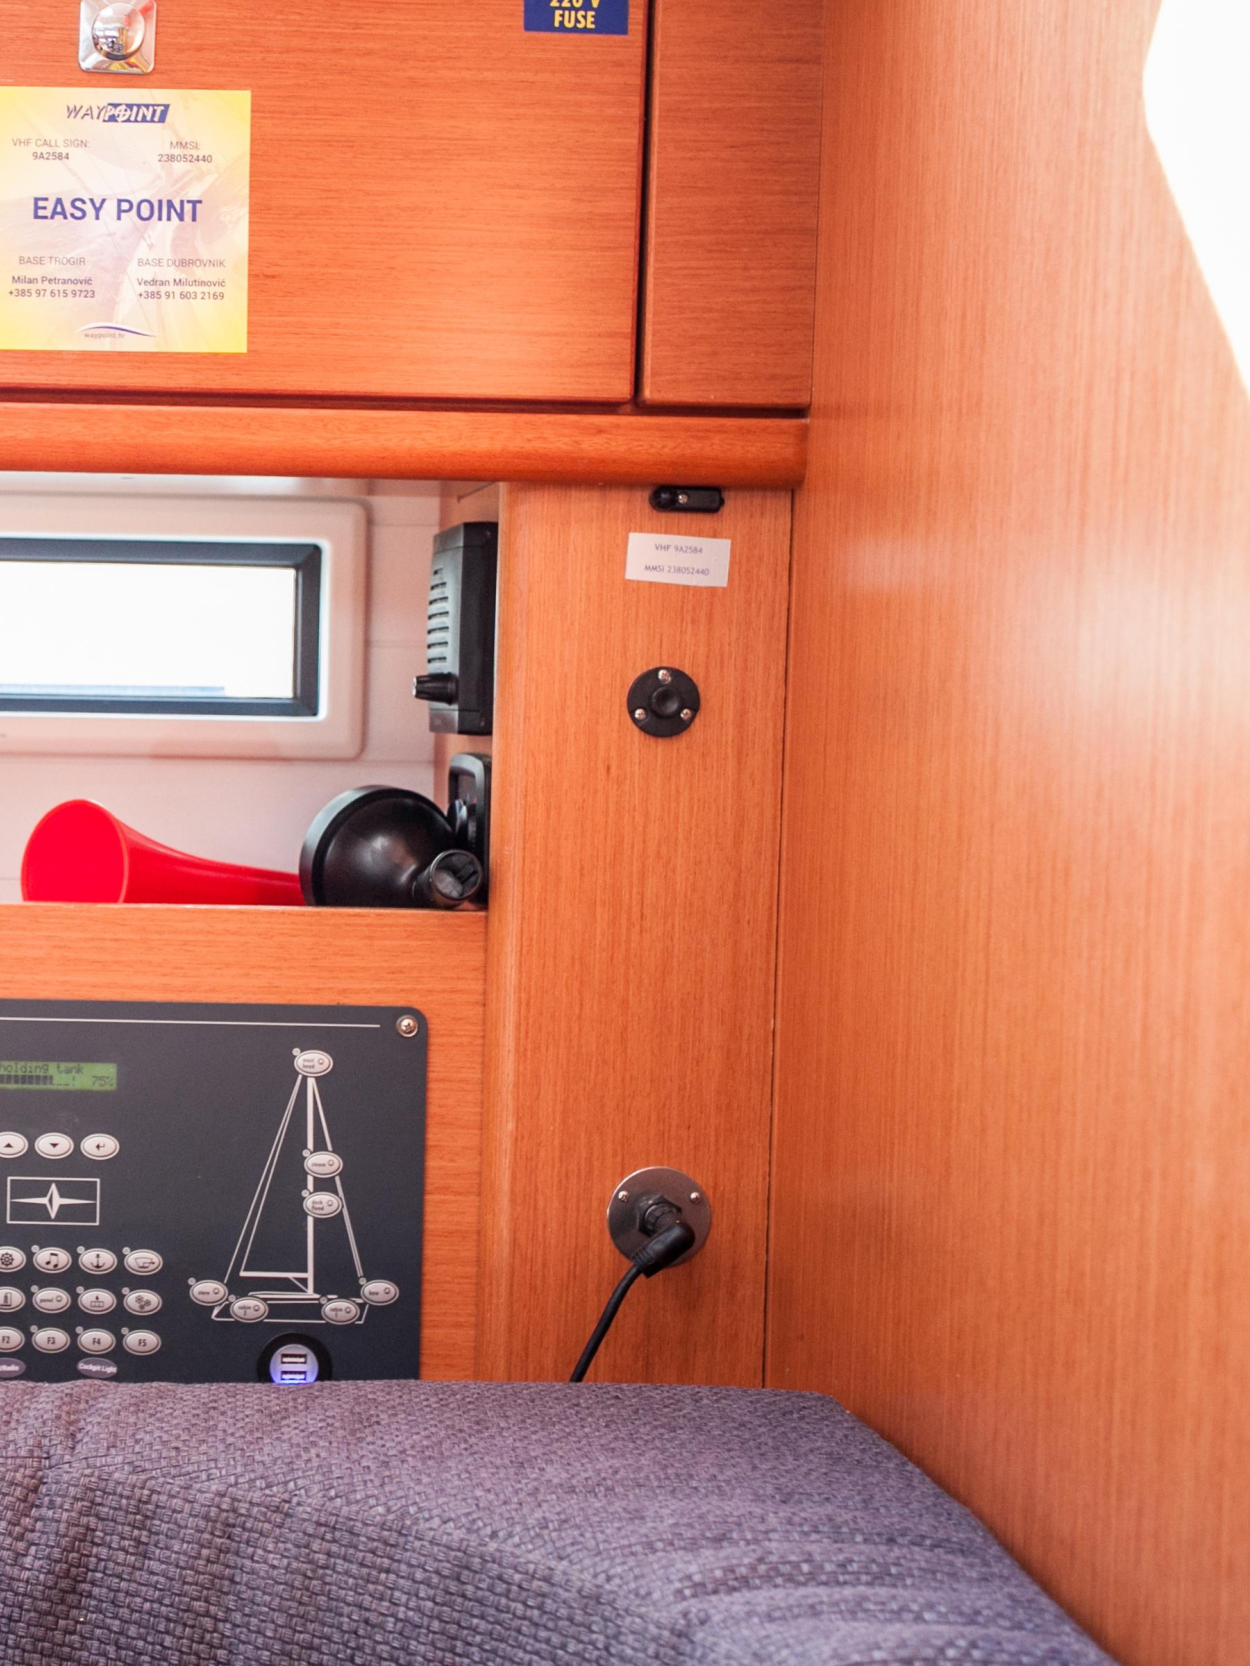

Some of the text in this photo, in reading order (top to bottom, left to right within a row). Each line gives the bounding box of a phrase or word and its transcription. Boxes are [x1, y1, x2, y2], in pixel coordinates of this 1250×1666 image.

[554, 9, 596, 29] FUSE
[66, 103, 165, 123] WAYPOINT
[11, 138, 90, 149] VHF CALL SIGN:
[32, 151, 70, 161] 9A2584
[158, 154, 213, 164] 238052440
[32, 197, 203, 222] EASY POINT
[19, 256, 86, 267] BASE TROGIR
[137, 257, 226, 269] BASE DUBROVNIK
[12, 275, 93, 286] Milan Petranović
[137, 277, 226, 288] Vedran Milutinović
[8, 288, 96, 299] +385 97 615 9723
[138, 290, 224, 300] +385 91 603 2169
[654, 543, 703, 554] VHF 9A2584
[644, 564, 710, 576] MMSI 238052440
[56, 1063, 84, 1074] tank
[92, 1075, 114, 1087] 75%
[1, 1335, 10, 1344] F2
[47, 1336, 56, 1345] F3
[92, 1337, 101, 1346] F4
[138, 1339, 147, 1347] F5
[78, 1363, 118, 1373] Cockpit Light
